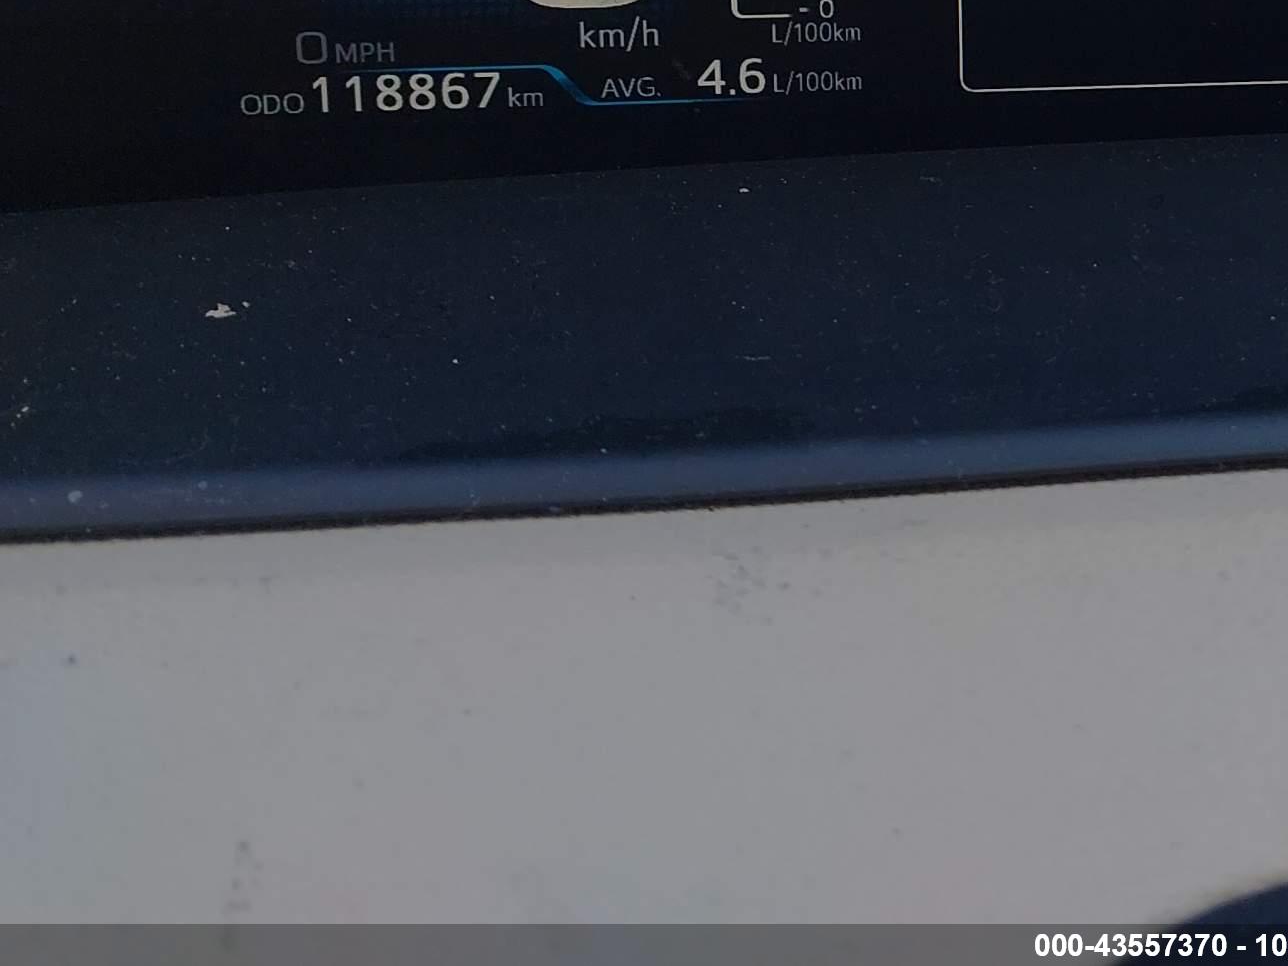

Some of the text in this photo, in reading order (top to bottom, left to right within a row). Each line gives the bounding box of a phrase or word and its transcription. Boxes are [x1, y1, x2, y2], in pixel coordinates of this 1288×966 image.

[820, 0, 833, 18] 0
[296, 32, 394, 64] 0 MPH
[580, 19, 658, 51] km/h
[772, 21, 860, 45] L/100km
[241, 72, 543, 115] ODO 118867 km
[602, 58, 861, 98] AVG. 4.6 L/100km
